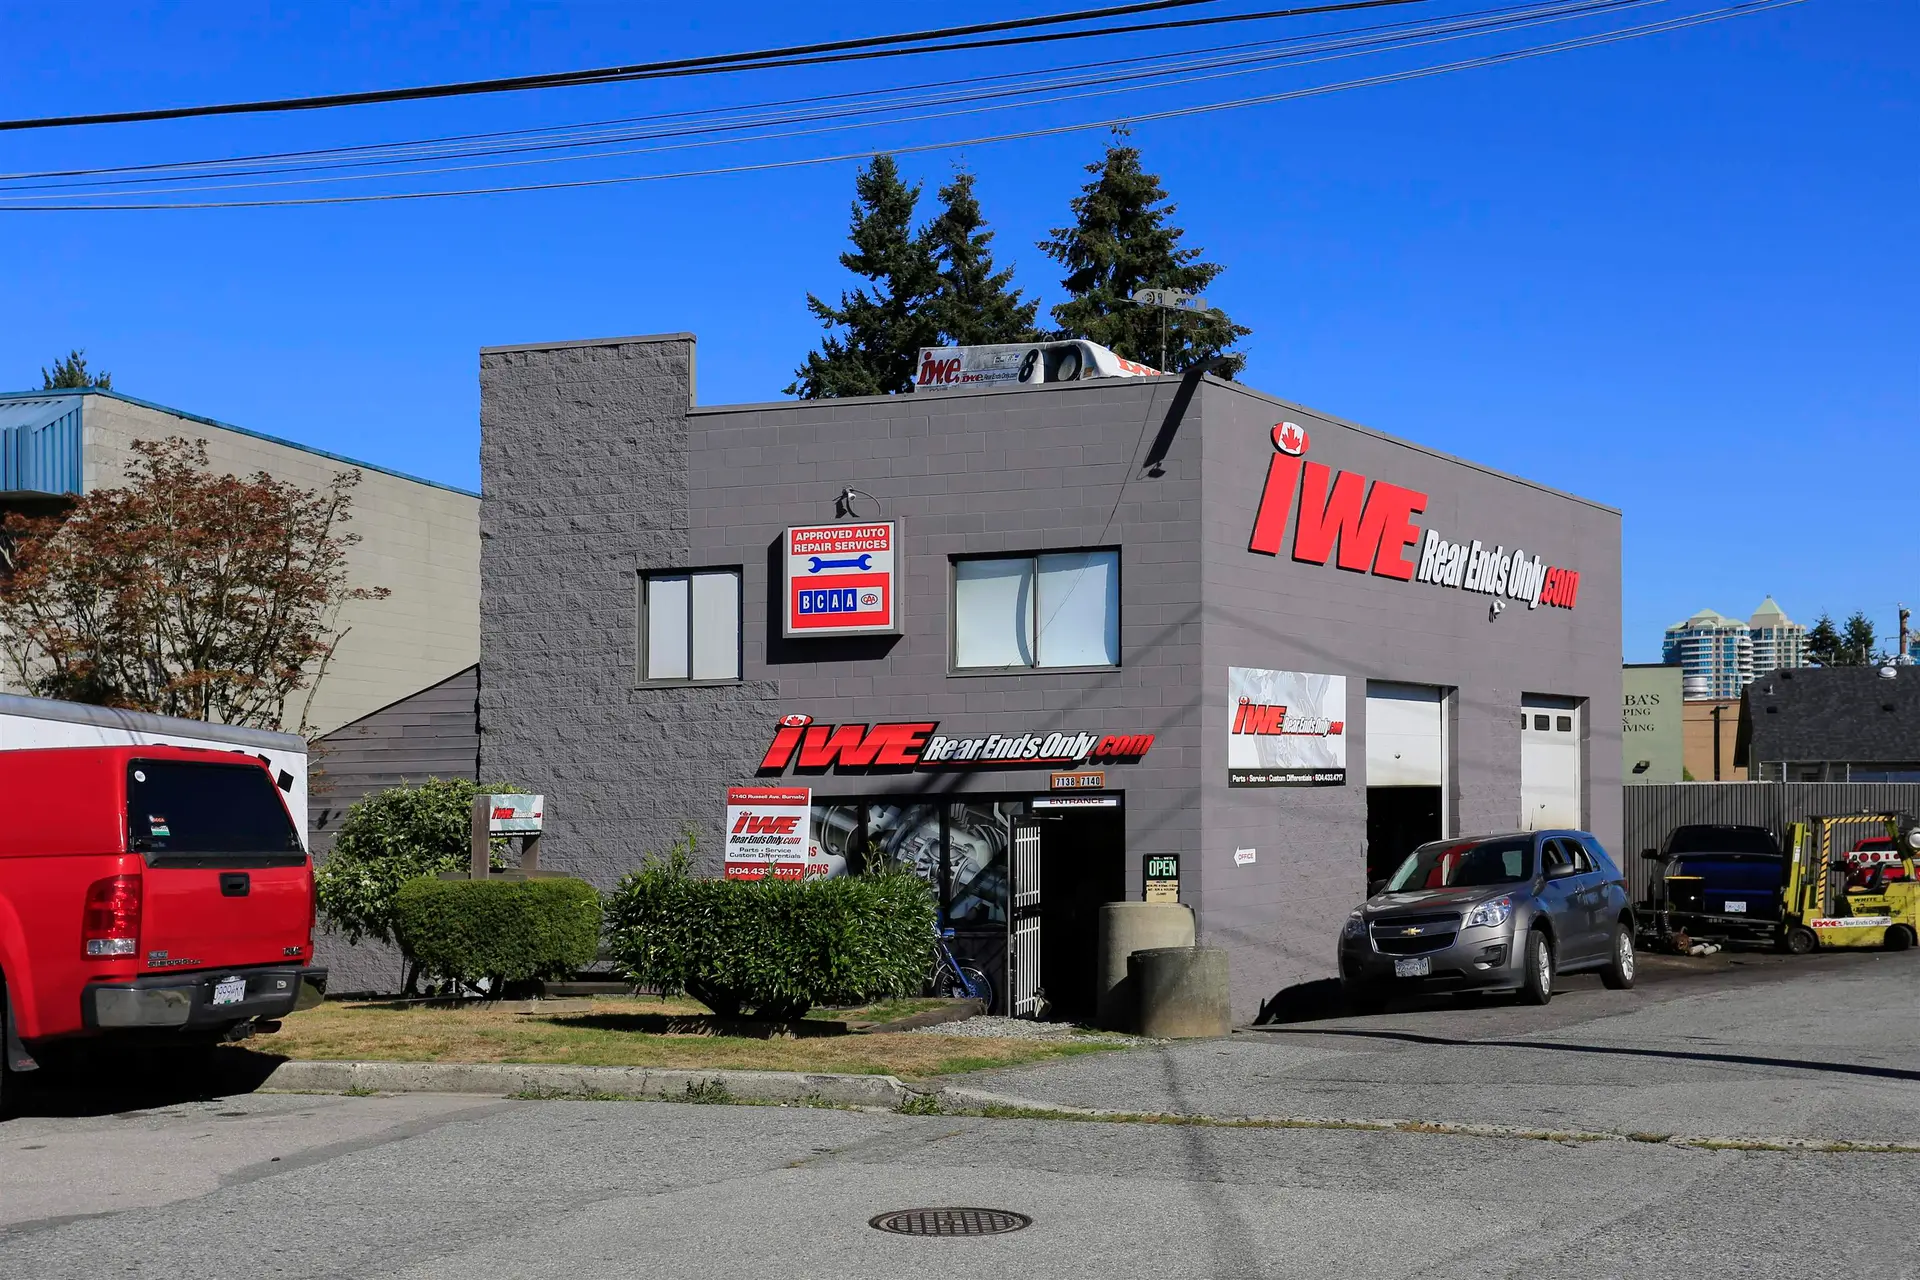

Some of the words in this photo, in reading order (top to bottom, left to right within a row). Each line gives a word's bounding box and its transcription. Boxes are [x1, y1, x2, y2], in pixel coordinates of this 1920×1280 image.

[1018, 349, 1039, 383] 8
[796, 530, 853, 541] APPROVED
[855, 528, 885, 539] AUTO
[794, 542, 832, 553] REPAIR
[834, 540, 888, 551] SERVICES
[802, 593, 854, 610] BCAA
[1622, 694, 1660, 706] BA'S
[1056, 777, 1075, 786] 7138
[1081, 776, 1100, 786] 7140
[1232, 774, 1246, 782] Parts
[1269, 774, 1285, 782] Custom
[1286, 774, 1312, 782] Differentials
[781, 793, 806, 801] Burnaby
[1049, 797, 1105, 805] ENTRANCE
[1149, 860, 1177, 876] OPEN
